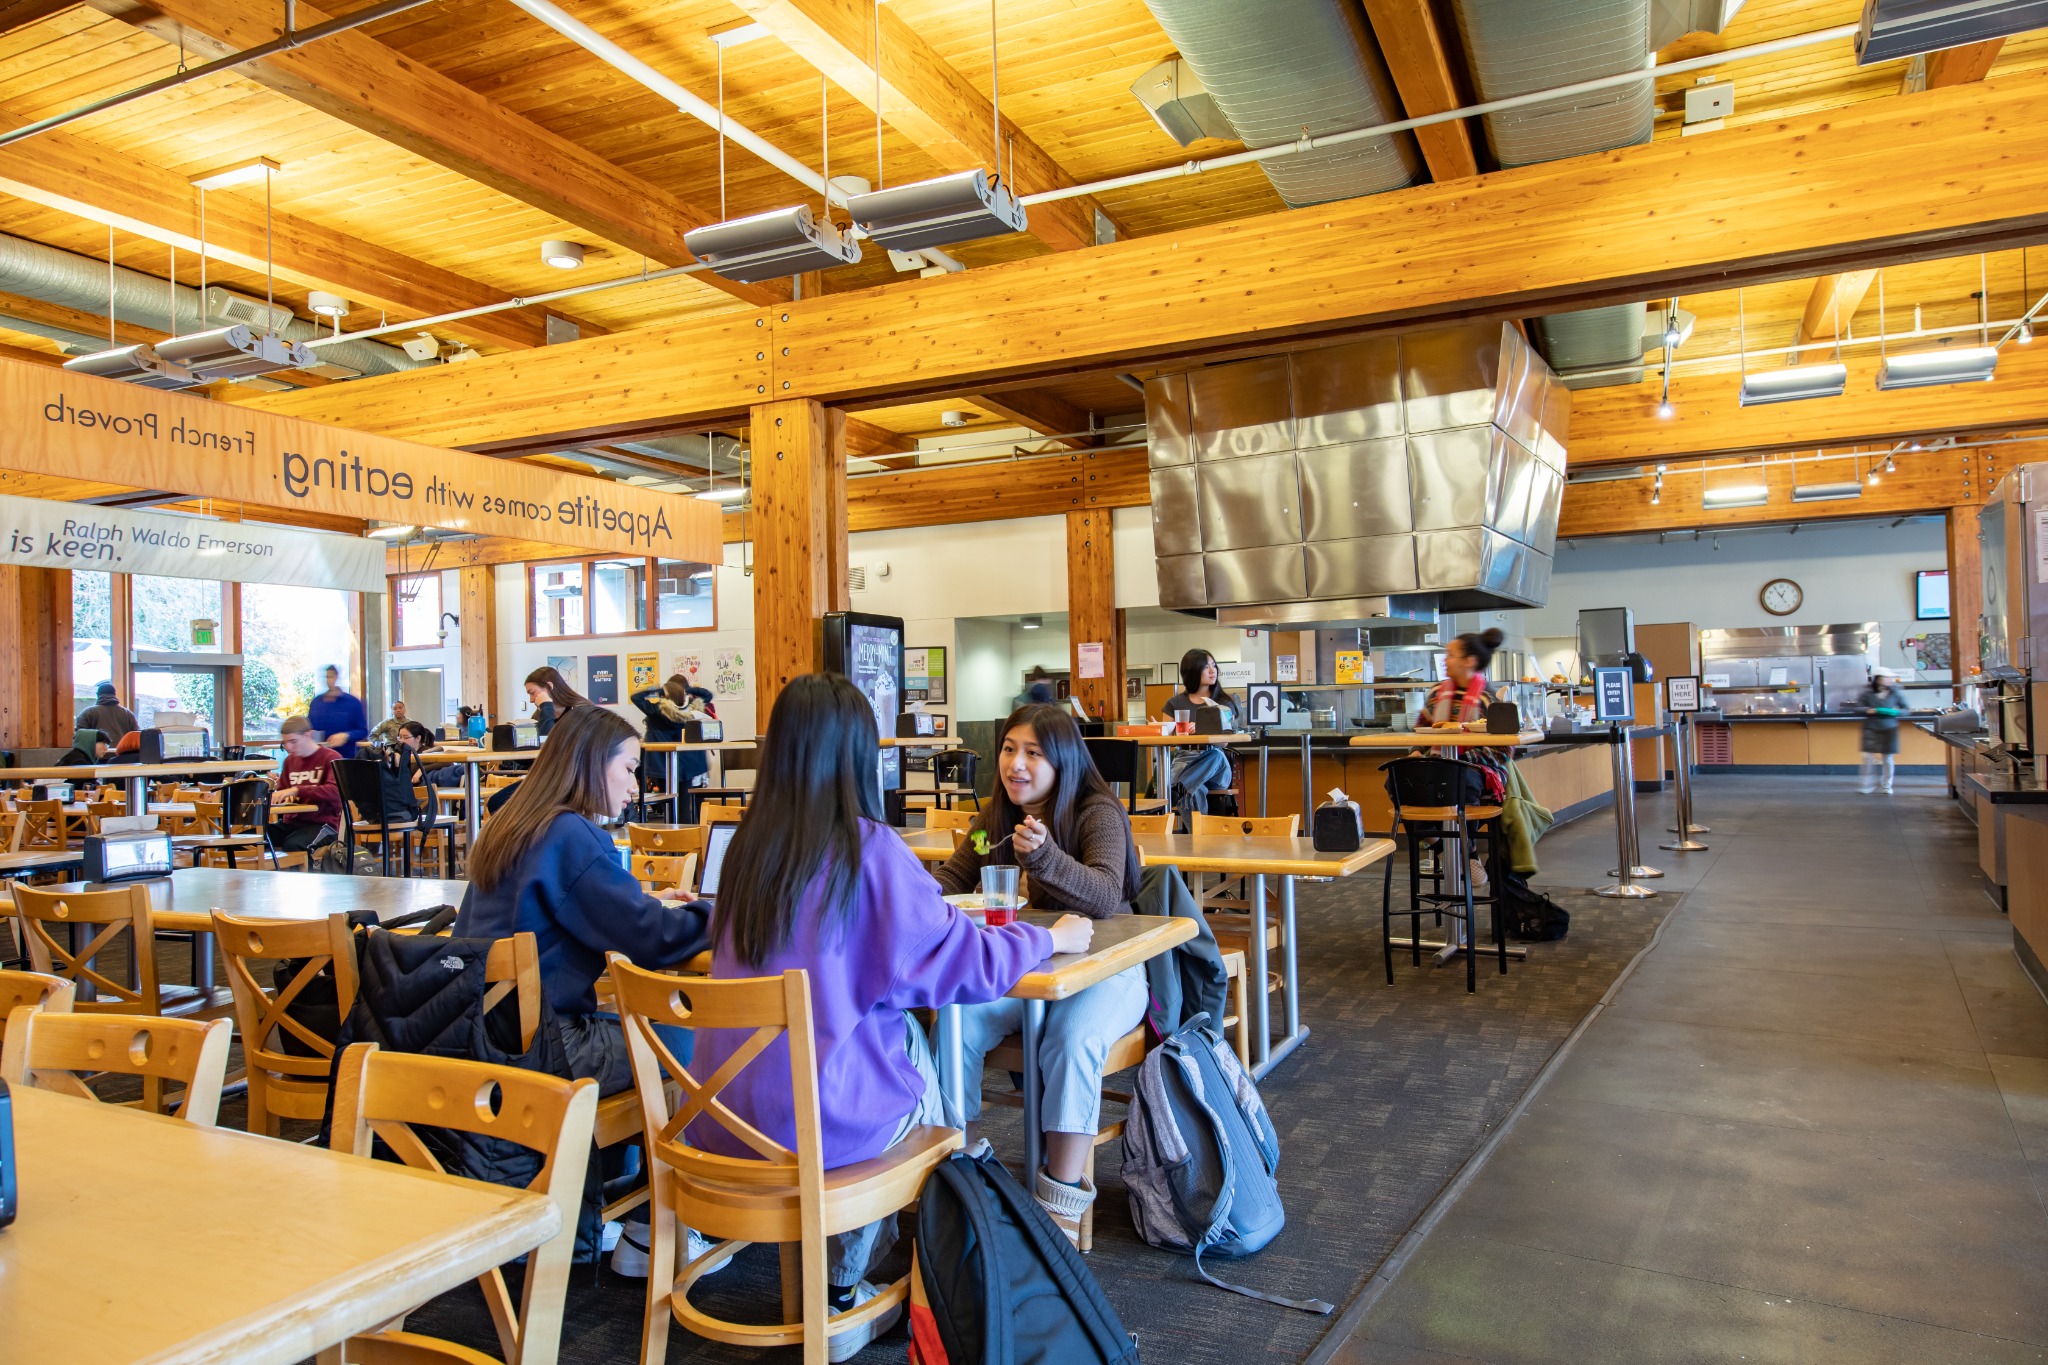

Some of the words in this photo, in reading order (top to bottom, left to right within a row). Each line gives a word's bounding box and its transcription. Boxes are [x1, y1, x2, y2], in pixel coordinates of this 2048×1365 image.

[11, 529, 34, 554] is
[46, 532, 122, 562] keen.
[63, 519, 123, 542] Ralph
[132, 526, 191, 549] Waldo
[197, 534, 274, 557] Emerson
[196, 631, 213, 644] EXIT
[289, 769, 323, 785] SPU
